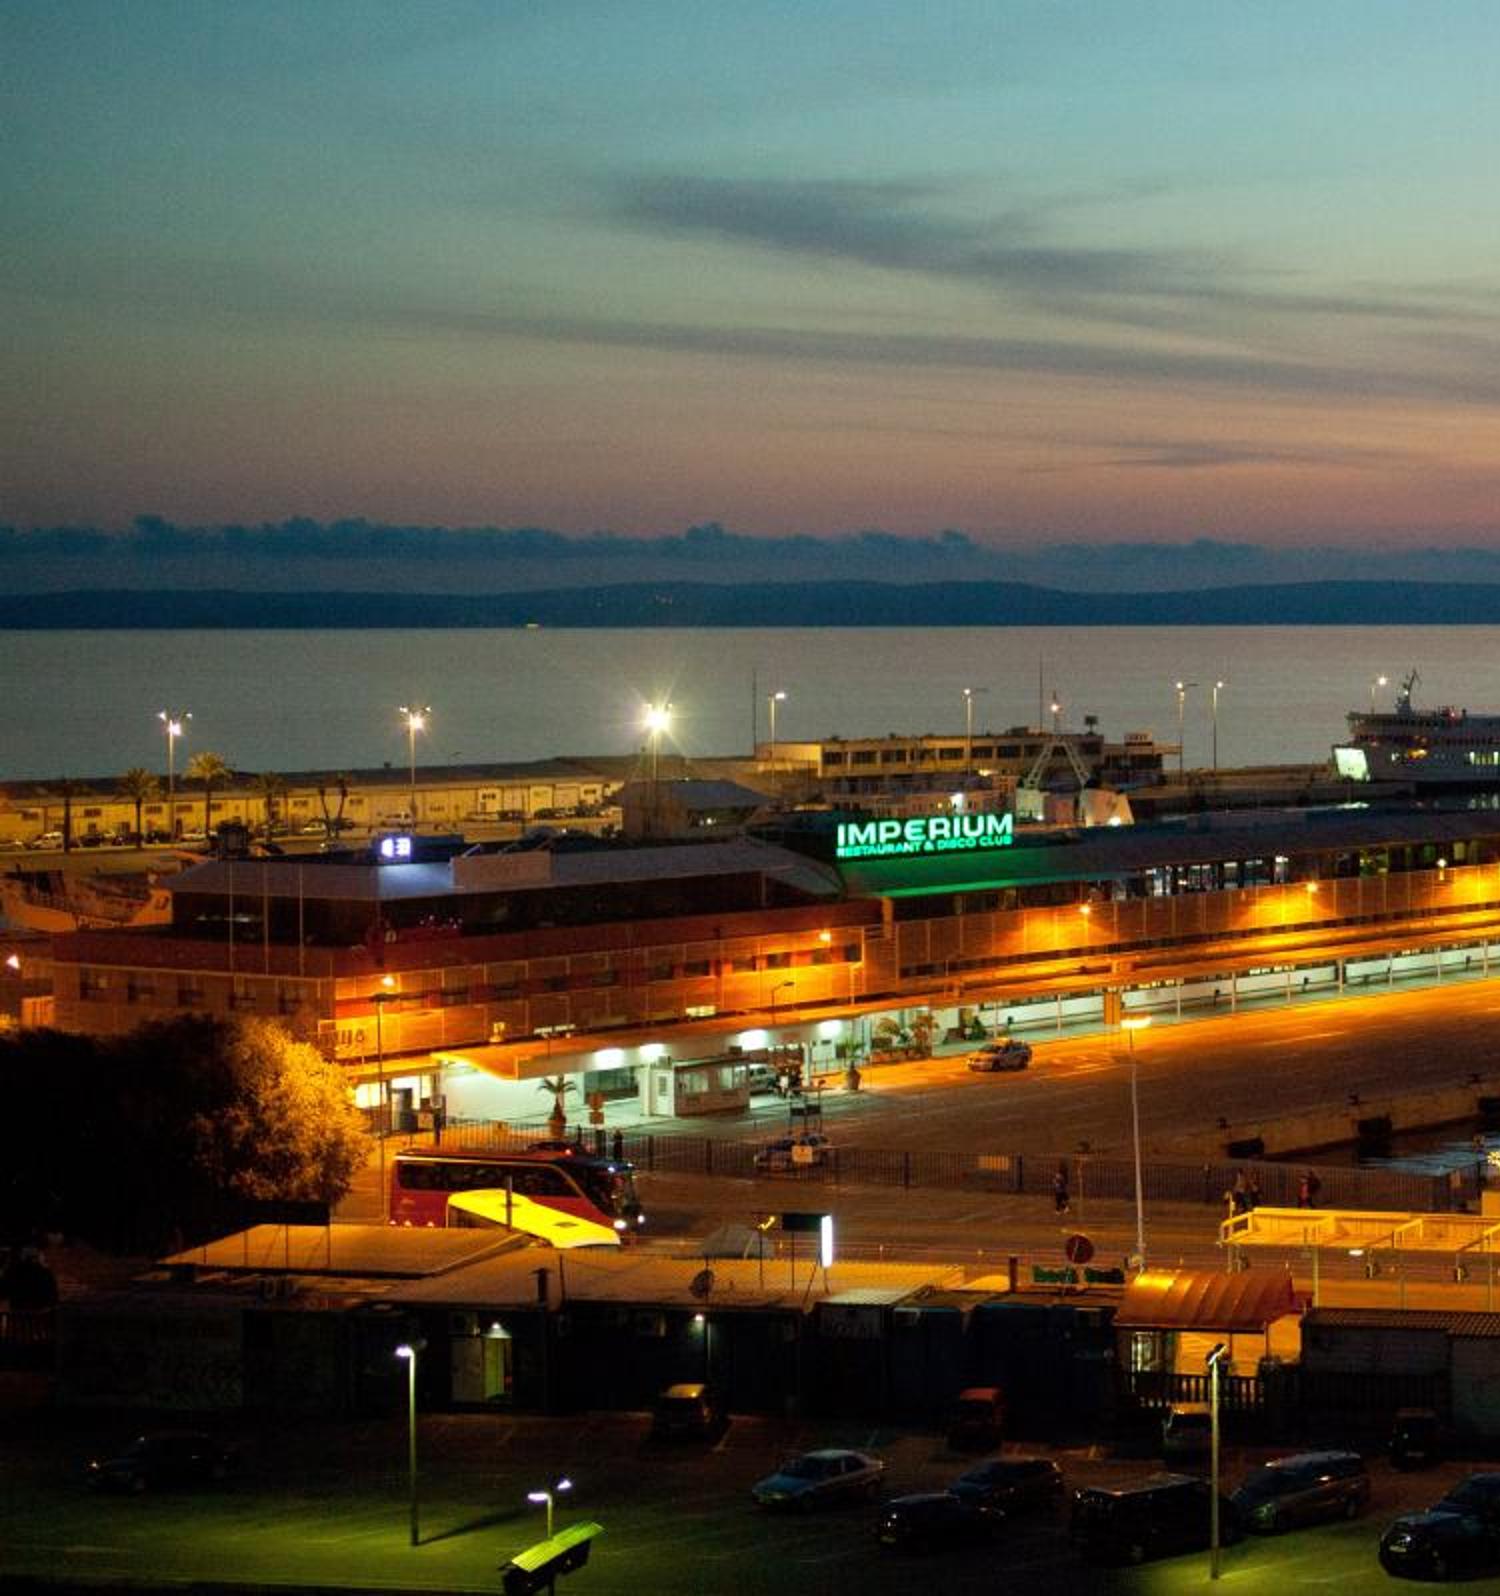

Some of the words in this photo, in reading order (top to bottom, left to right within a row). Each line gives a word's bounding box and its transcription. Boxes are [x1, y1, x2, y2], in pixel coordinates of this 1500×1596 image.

[837, 814, 1013, 846] IMPERIUM
[836, 842, 922, 857] RESTAURANT
[924, 841, 935, 851] &
[937, 838, 977, 850] DISCO
[979, 834, 1013, 845] CLUB
